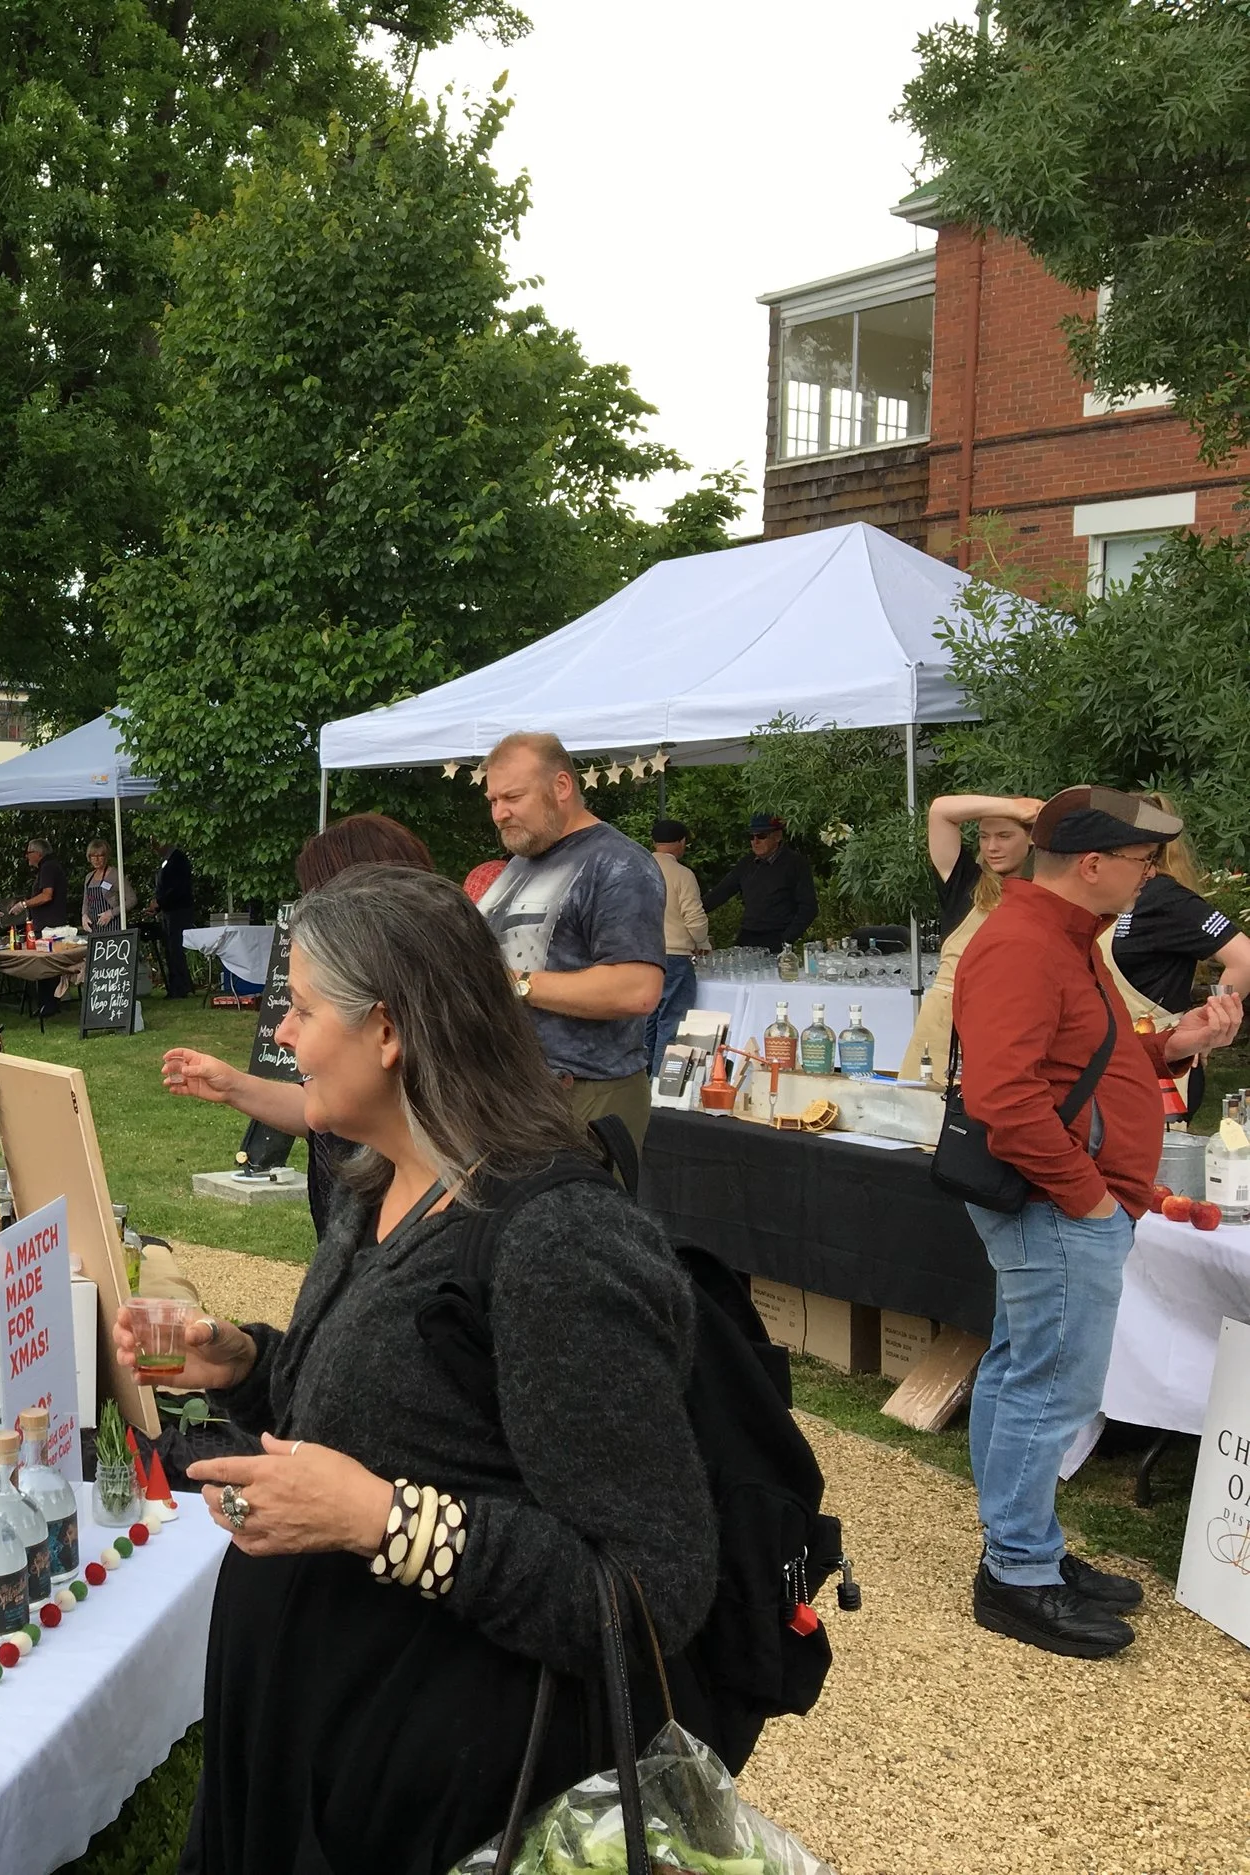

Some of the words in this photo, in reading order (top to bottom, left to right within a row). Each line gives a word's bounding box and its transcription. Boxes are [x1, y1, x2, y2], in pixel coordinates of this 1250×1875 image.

[94, 940, 130, 964] BBQ
[90, 966, 129, 984] Sausage
[109, 1010, 123, 1021] $4
[4, 1251, 14, 1280] A
[17, 1223, 59, 1270] MATCH
[5, 1265, 43, 1312] MADE
[7, 1305, 35, 1346] FOR
[9, 1327, 50, 1381] XMAS!
